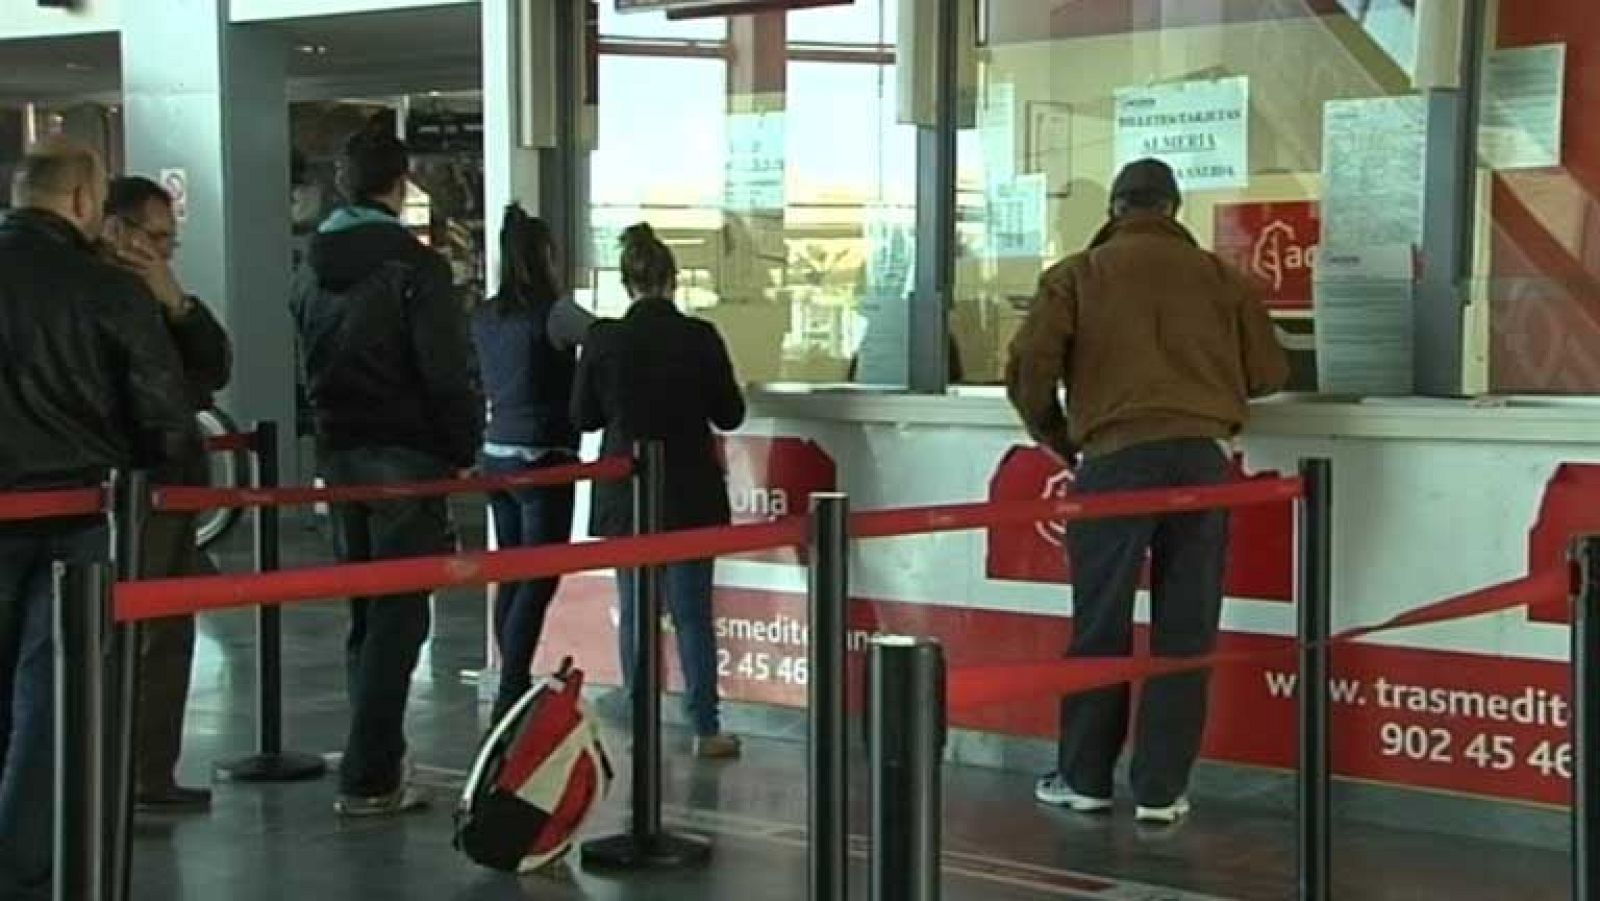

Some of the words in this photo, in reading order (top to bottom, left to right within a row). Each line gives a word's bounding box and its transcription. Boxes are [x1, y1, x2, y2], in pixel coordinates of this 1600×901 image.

[729, 487, 788, 515] ona
[738, 653, 770, 680] 45
[776, 656, 808, 685] 46
[1374, 677, 1568, 727] trasmedit
[1380, 722, 1453, 763] 902
[1464, 733, 1516, 769] 45
